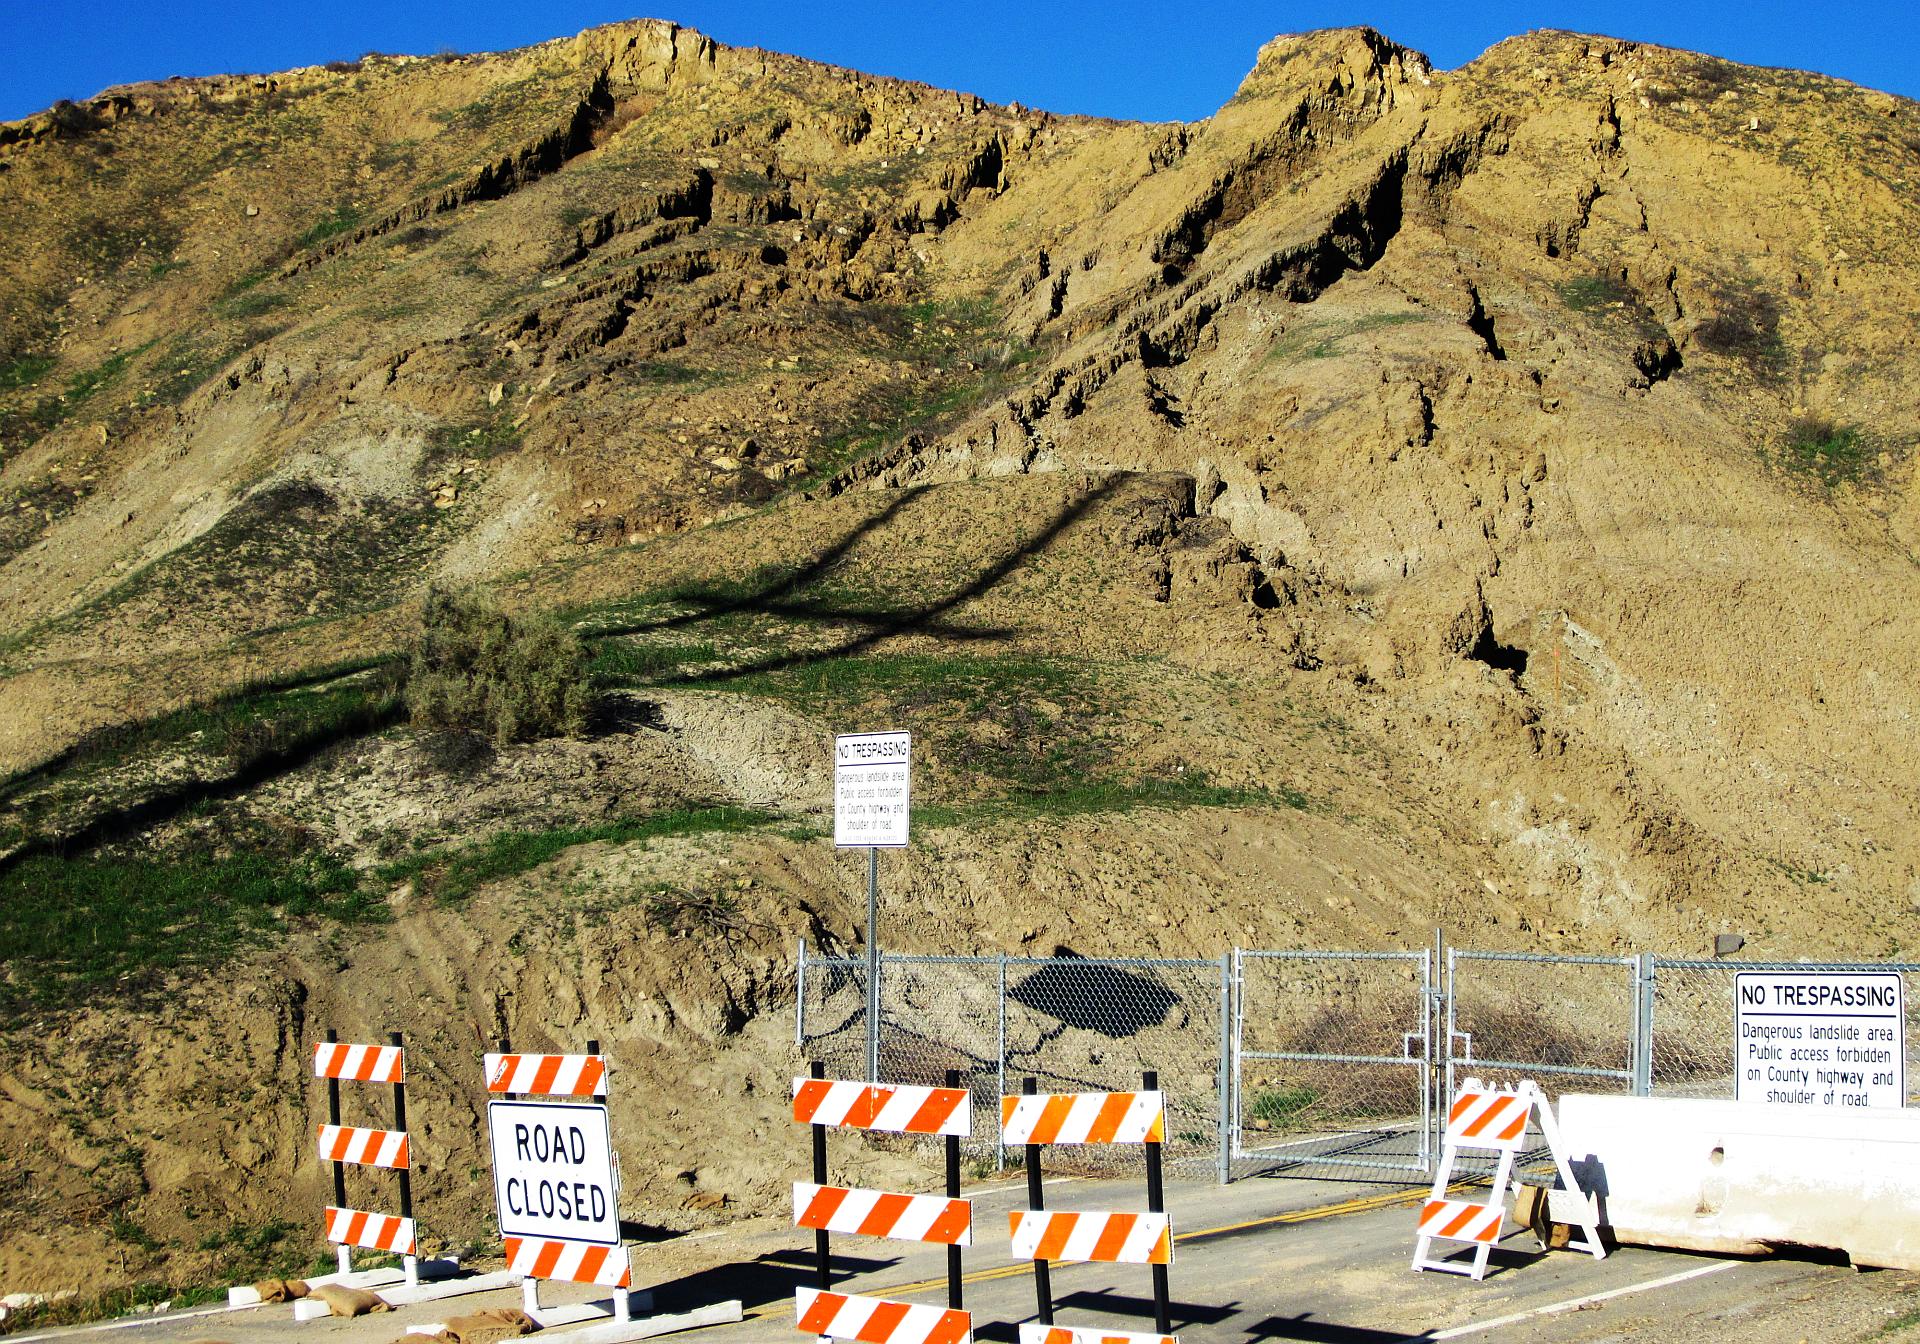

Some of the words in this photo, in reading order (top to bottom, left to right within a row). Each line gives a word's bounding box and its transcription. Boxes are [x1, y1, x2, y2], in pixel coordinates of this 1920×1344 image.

[838, 745, 849, 759] NO
[852, 741, 907, 758] TRESPASSING
[838, 772, 863, 786] Dangerous
[867, 771, 889, 782] landslide
[840, 787, 855, 799] Public
[857, 789, 875, 798] access
[877, 787, 903, 798] forbidden
[848, 803, 866, 815] County
[868, 803, 890, 816] highway
[893, 803, 904, 814] and
[847, 820, 868, 830] shoulder
[872, 819, 878, 830] of
[1742, 985, 1766, 1005] NO
[1773, 985, 1895, 1007] TRESPASSING
[1742, 1022, 1803, 1043] Dangerous
[1809, 1024, 1860, 1041] landslide
[1867, 1028, 1896, 1042] area.
[1749, 1043, 1783, 1060] Public
[1790, 1048, 1829, 1062] access
[1837, 1046, 1891, 1063] forbidden
[1747, 1067, 1761, 1081] on
[1767, 1066, 1809, 1087] County
[1816, 1068, 1864, 1089] highway
[1872, 1070, 1894, 1086] and
[1767, 1088, 1816, 1104] shoulder
[1823, 1090, 1835, 1105] of
[1841, 1091, 1871, 1107] road.
[515, 1123, 585, 1165] ROAD
[507, 1177, 606, 1223] CLOSED
